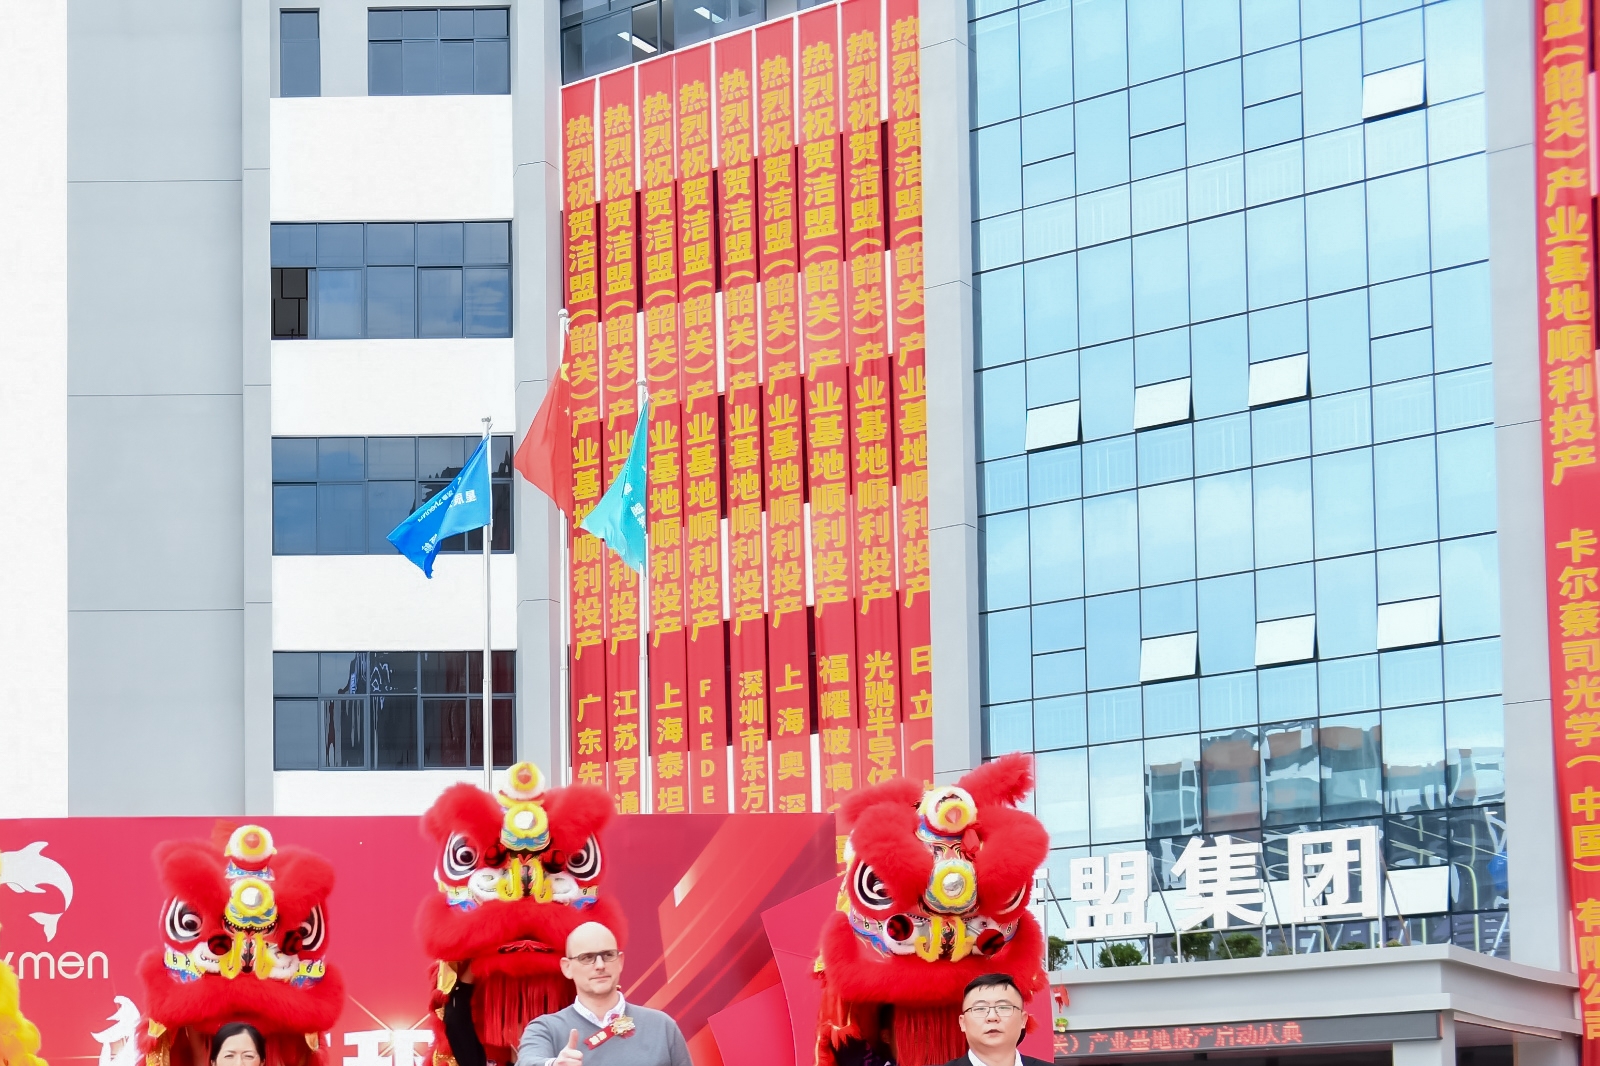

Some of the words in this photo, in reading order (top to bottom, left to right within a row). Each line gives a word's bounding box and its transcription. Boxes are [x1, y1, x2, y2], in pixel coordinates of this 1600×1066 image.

[603, 103, 638, 655] 热烈祝贺洁盟（韶关）产业利投产
[642, 91, 683, 647] 热烈祝贺洁盟（韶关）产业基地顺利投产
[679, 80, 720, 641] 热烈祝贺洁盟（韶关）产业基地顺利投产
[719, 68, 764, 636] 热烈祝贺洁盟（韶关）产业基地顺利投产
[760, 55, 803, 628] 热烈祝贺洁盟（韶关）产业基地顺利投产
[801, 41, 849, 618] 热烈祝贺洁盟（韶关）产业基地顺利投产
[846, 29, 893, 614] 热烈祝贺洁盟（韶关）产业基地顺利投产
[612, 690, 638, 813] 江苏亨通
[655, 682, 685, 813] 上海泰坦
[699, 678, 716, 804] FREDE
[738, 669, 767, 813] 深圳市东方
[910, 644, 934, 790] 日立（
[1032, 826, 1378, 939] 盟集团
